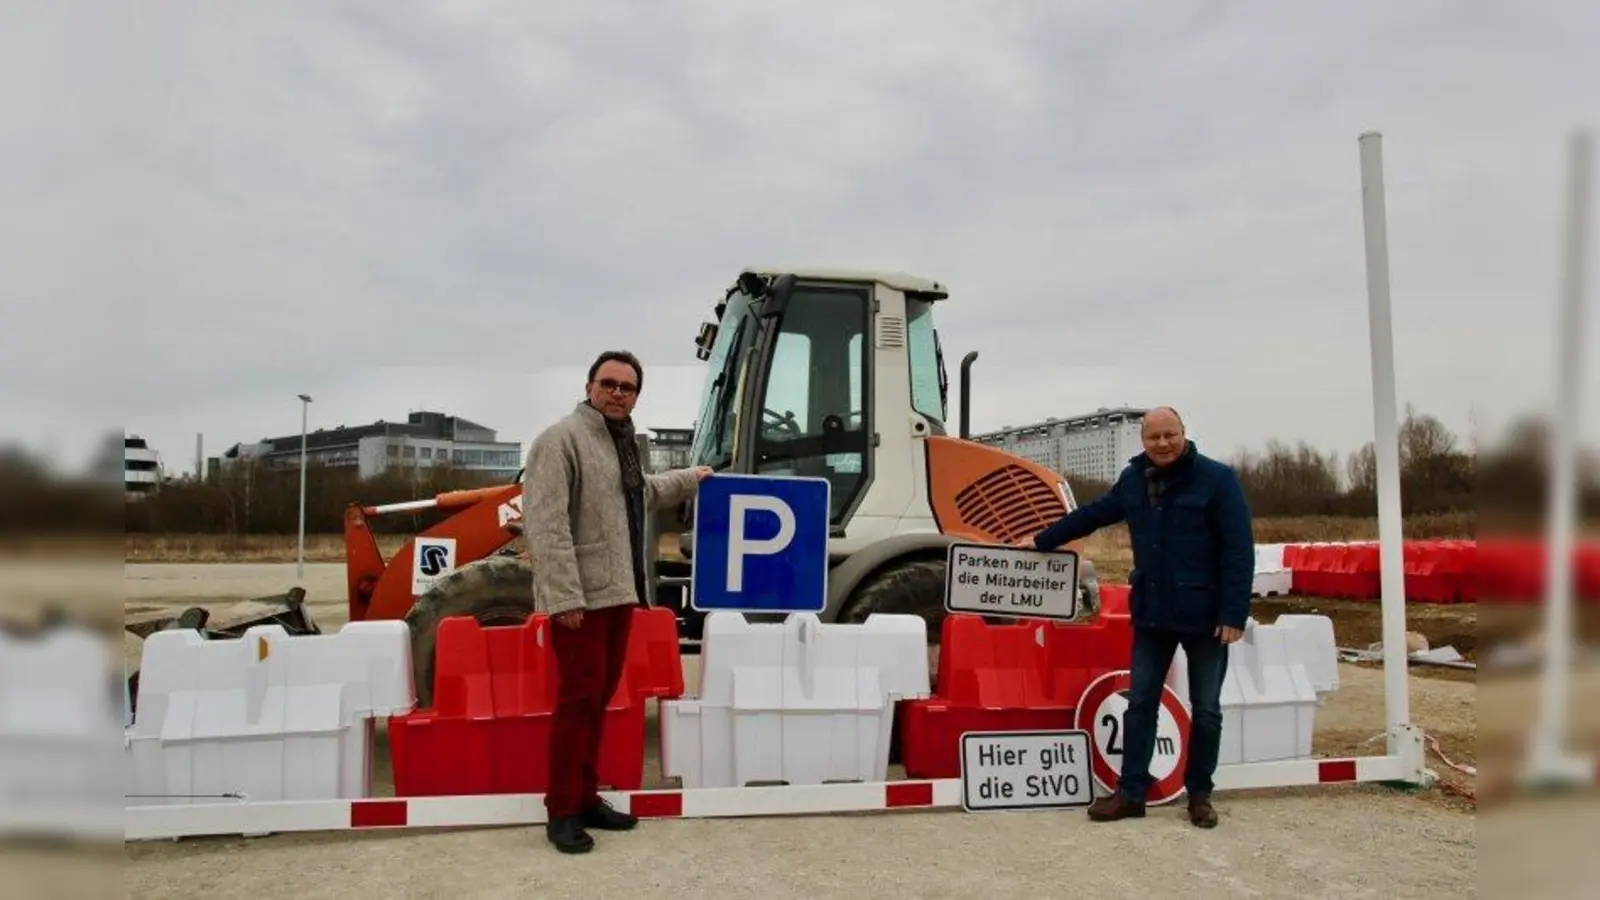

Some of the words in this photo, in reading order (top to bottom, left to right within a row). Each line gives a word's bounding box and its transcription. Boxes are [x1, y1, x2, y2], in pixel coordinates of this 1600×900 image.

[726, 494, 796, 592] P
[958, 553, 1009, 569] Parken
[1014, 559, 1039, 571] nur
[1046, 559, 1069, 573] für
[958, 571, 980, 585] die
[985, 573, 1067, 590] Mitarbeiter
[980, 591, 1004, 604] der
[1010, 593, 1044, 607] LMU
[979, 744, 1027, 766] Hier
[1040, 743, 1075, 771] gilt
[979, 776, 1014, 799] die
[1026, 774, 1080, 797] StVO
